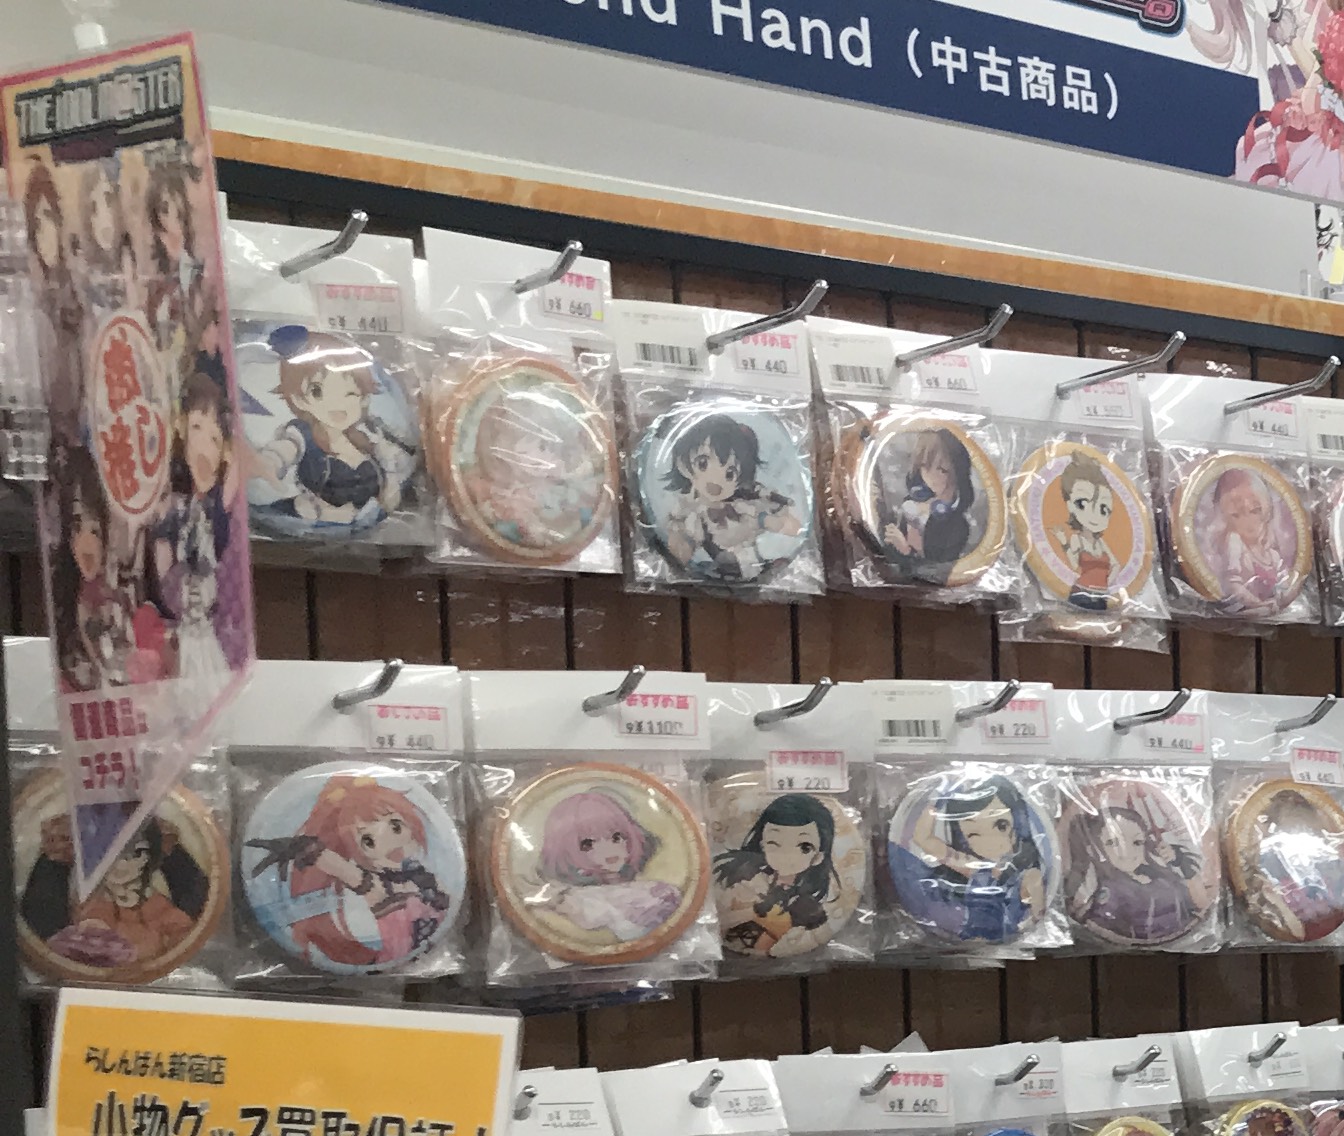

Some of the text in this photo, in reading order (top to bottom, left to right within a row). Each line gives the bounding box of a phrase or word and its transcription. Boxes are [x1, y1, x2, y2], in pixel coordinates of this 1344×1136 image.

[711, 0, 1119, 120] Hand （中古商品）
